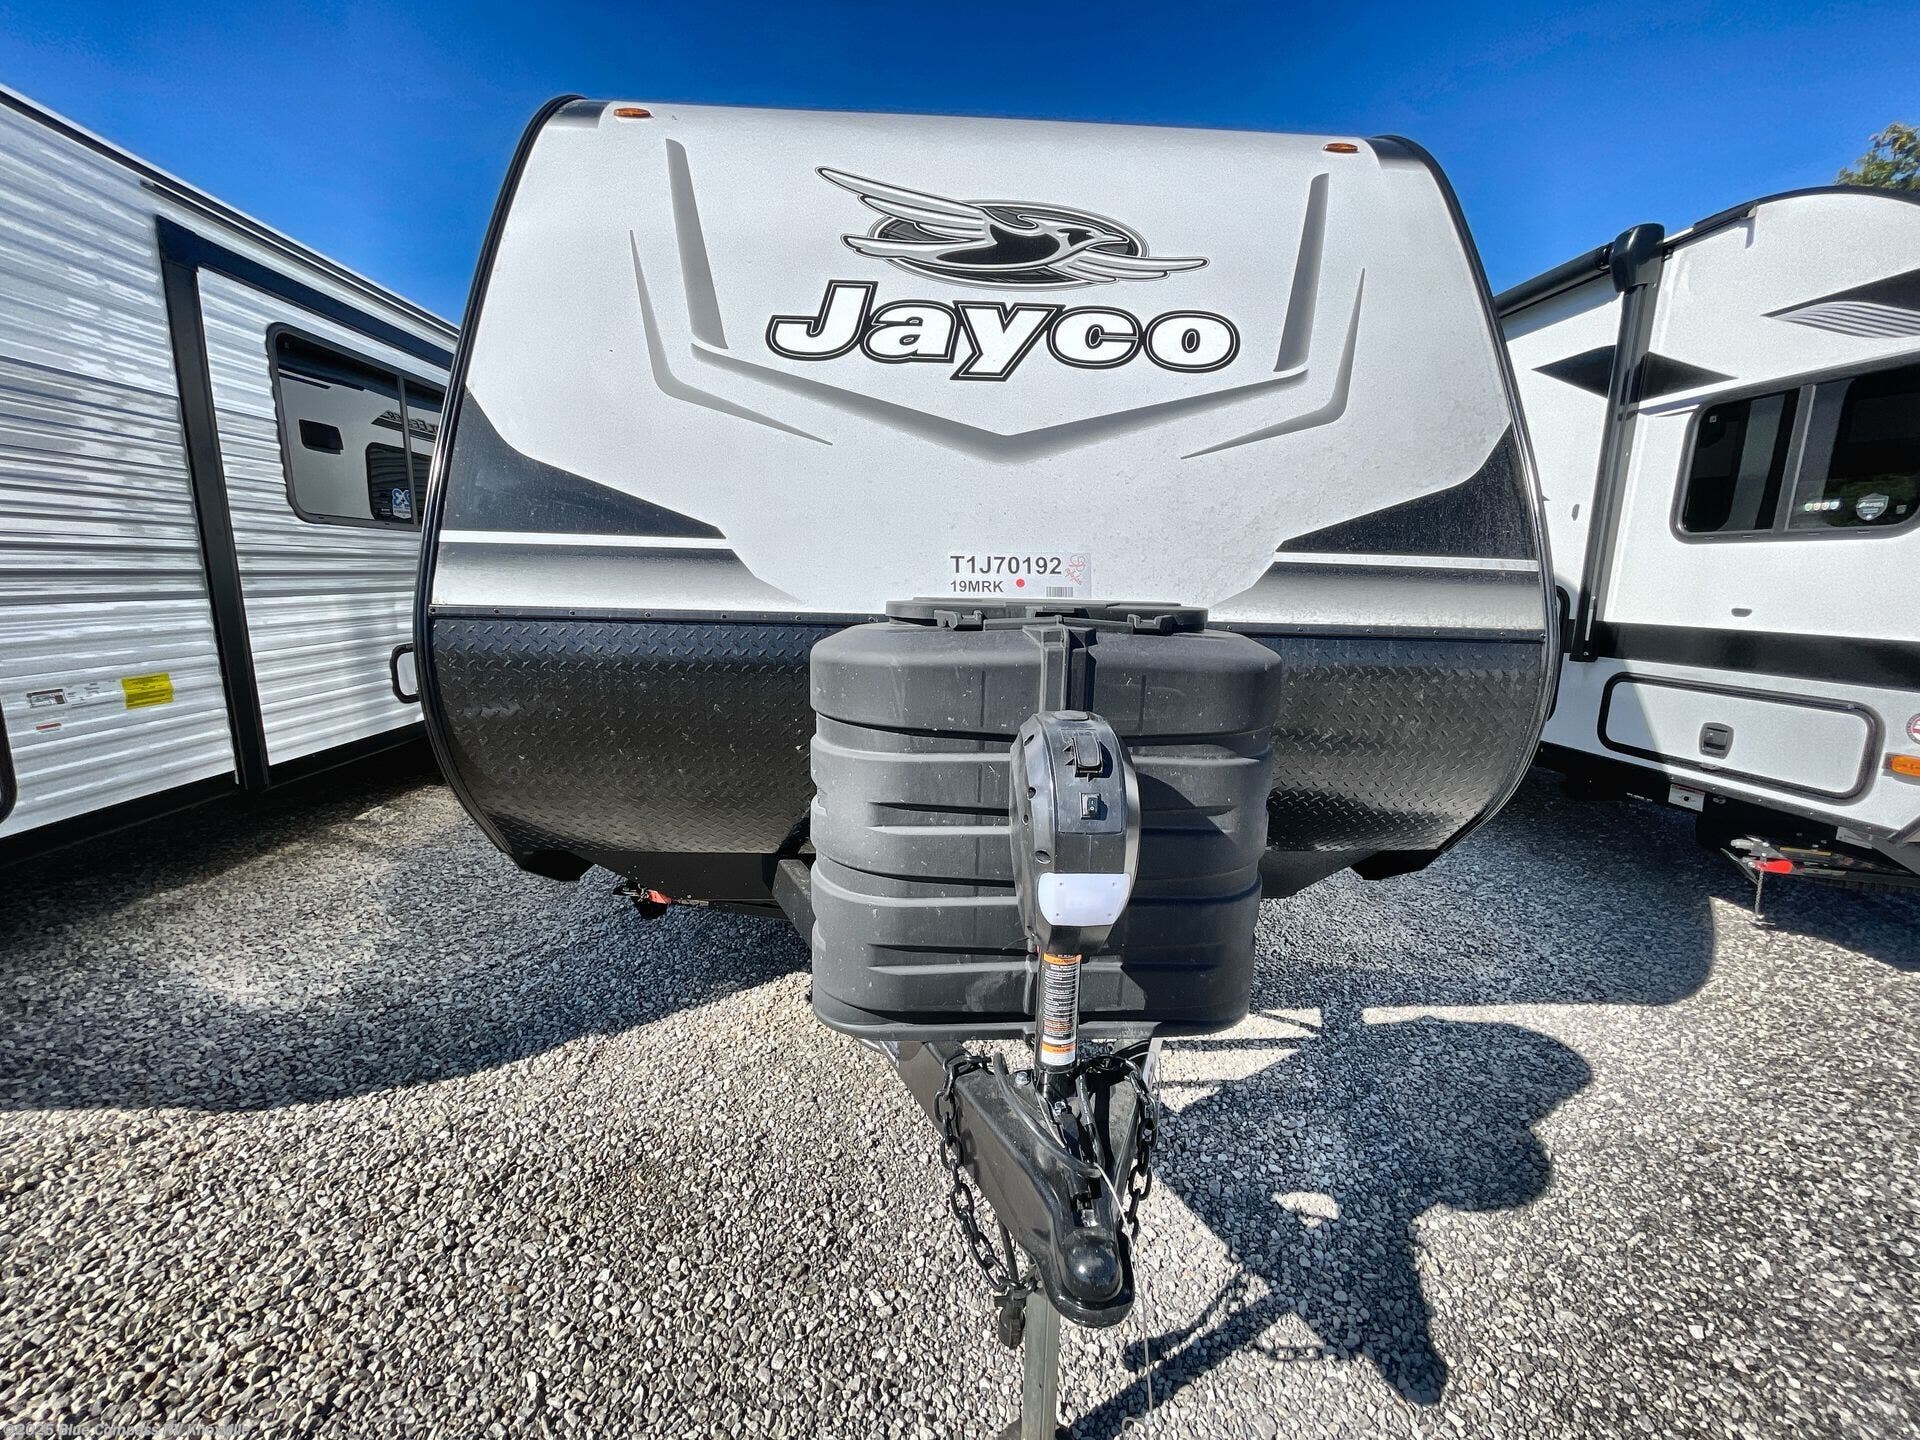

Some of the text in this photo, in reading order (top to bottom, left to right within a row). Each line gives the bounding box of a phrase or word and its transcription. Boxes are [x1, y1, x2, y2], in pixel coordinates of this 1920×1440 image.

[766, 280, 1241, 382] Jayco
[950, 555, 1062, 575] T1J70192
[950, 580, 1004, 593] 19MRK
